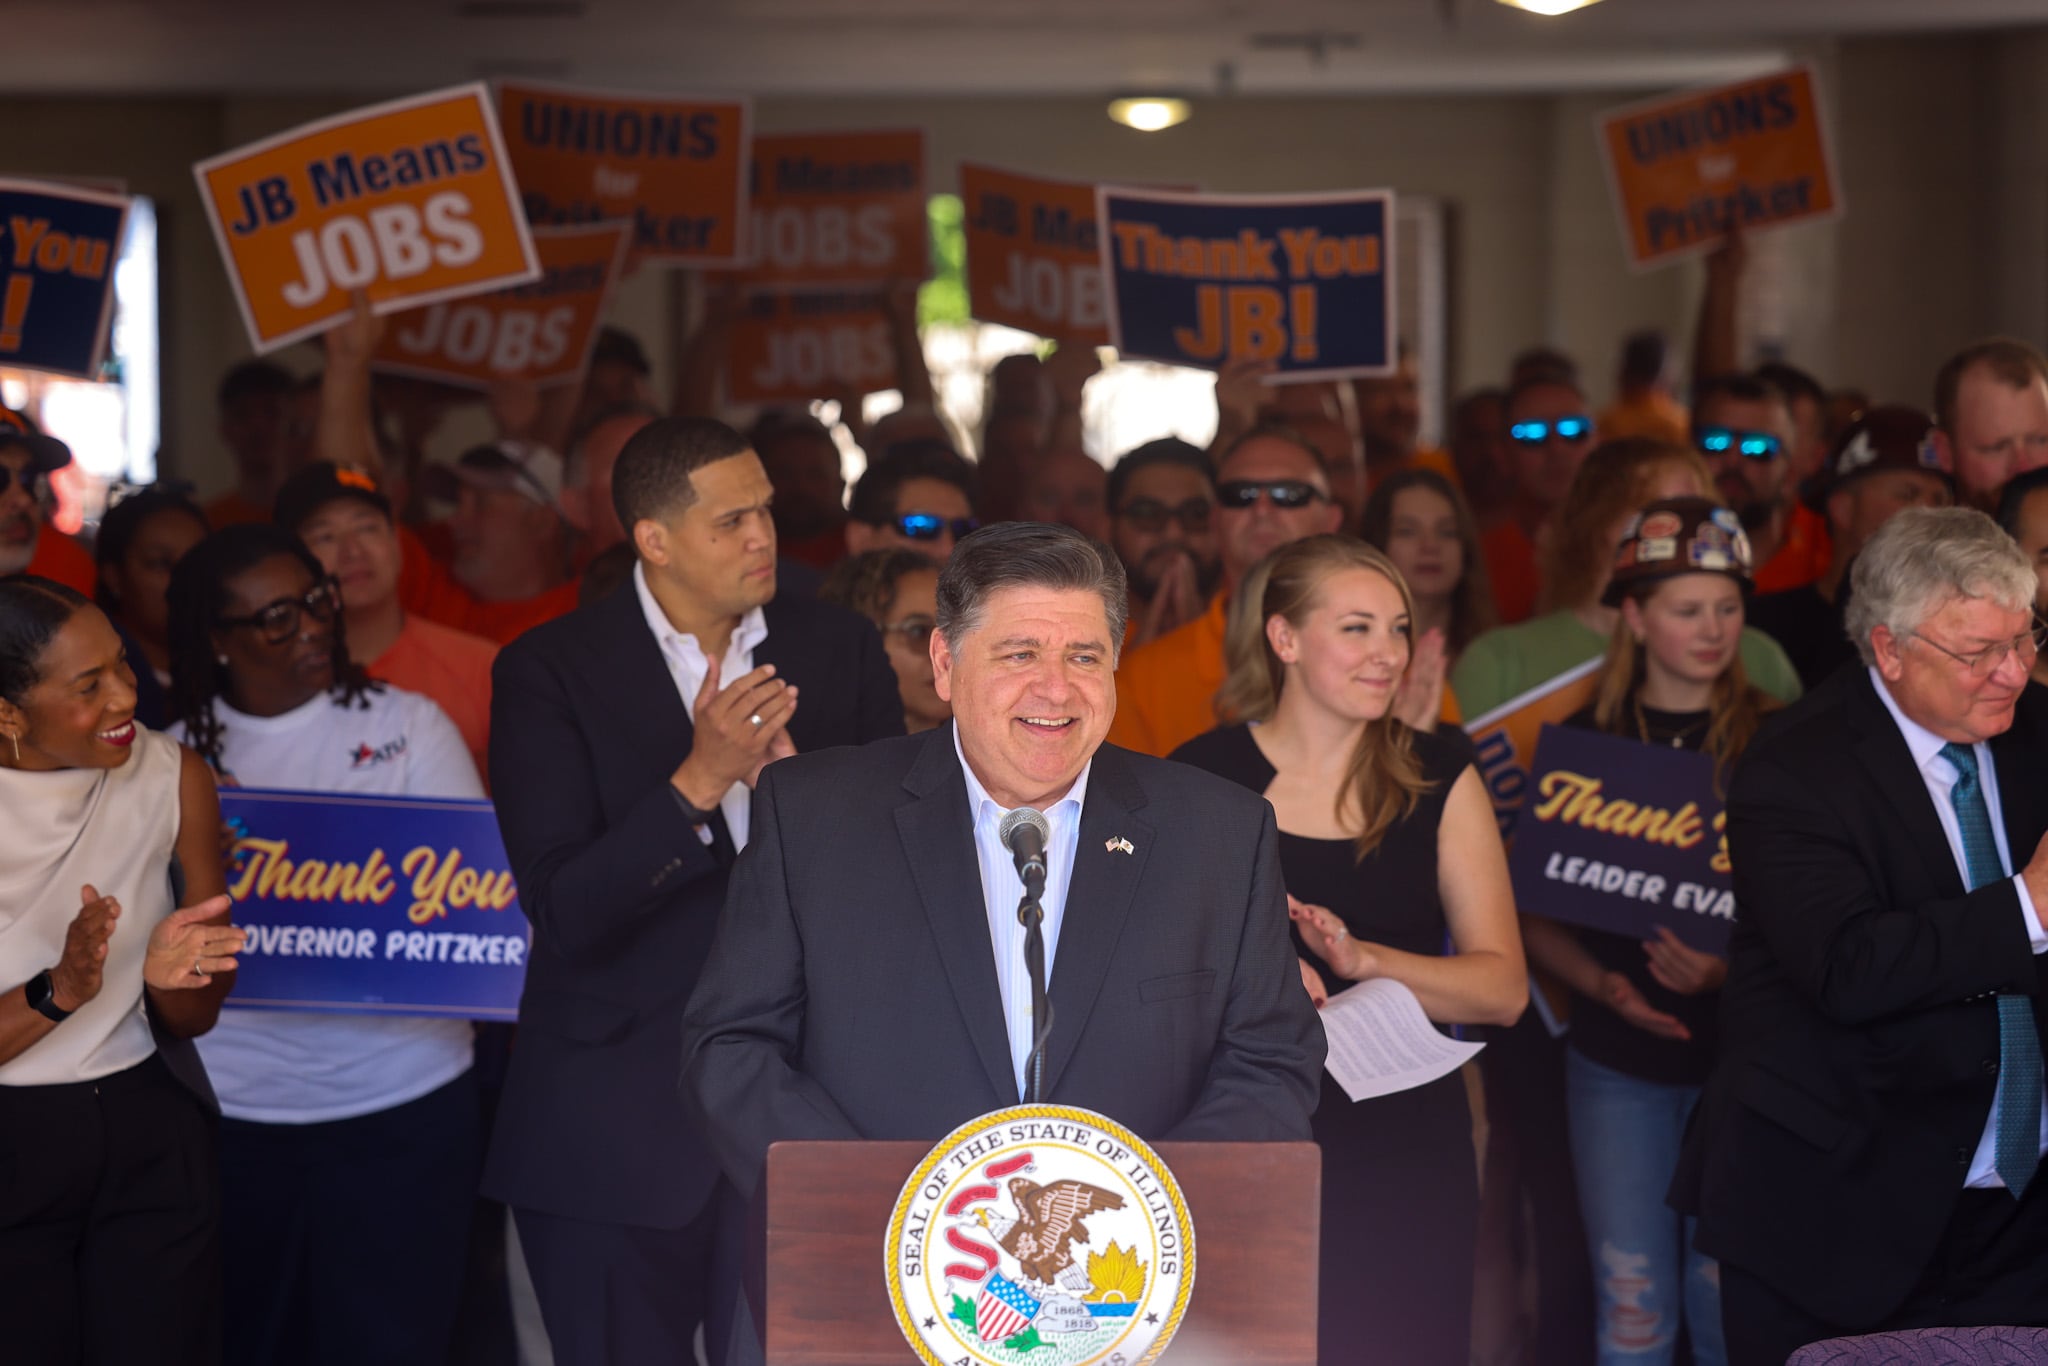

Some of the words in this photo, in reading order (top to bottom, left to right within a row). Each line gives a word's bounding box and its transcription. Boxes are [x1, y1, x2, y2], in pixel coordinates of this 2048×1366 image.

[521, 99, 720, 159] UNIONS
[1627, 82, 1797, 164] UNIONS
[231, 174, 298, 237] JB
[305, 133, 487, 209] Means
[591, 165, 641, 197] for
[9, 214, 110, 281] You
[283, 191, 485, 309] JOBS
[748, 204, 897, 269] JOBS
[1114, 220, 1278, 279] Thank
[1280, 229, 1381, 279] You
[992, 251, 1104, 330] JOB
[1173, 284, 1320, 364] JB!
[396, 301, 576, 372] JOBS
[752, 321, 896, 389] JOBS
[1533, 769, 1705, 850] Thank
[228, 836, 397, 903] Thank
[401, 845, 519, 926] You
[1544, 851, 1667, 905] LEADER
[1672, 881, 1738, 923] EVA
[231, 923, 377, 959] OVERNOR
[385, 930, 526, 966] PRITZKER
[904, 1207, 930, 1277] SEAL
[926, 1171, 950, 1202] OF
[950, 1130, 1004, 1170] THE
[1009, 1123, 1092, 1147] STATE
[1095, 1138, 1131, 1164] OF
[1127, 1166, 1178, 1275] ILLINOIS
